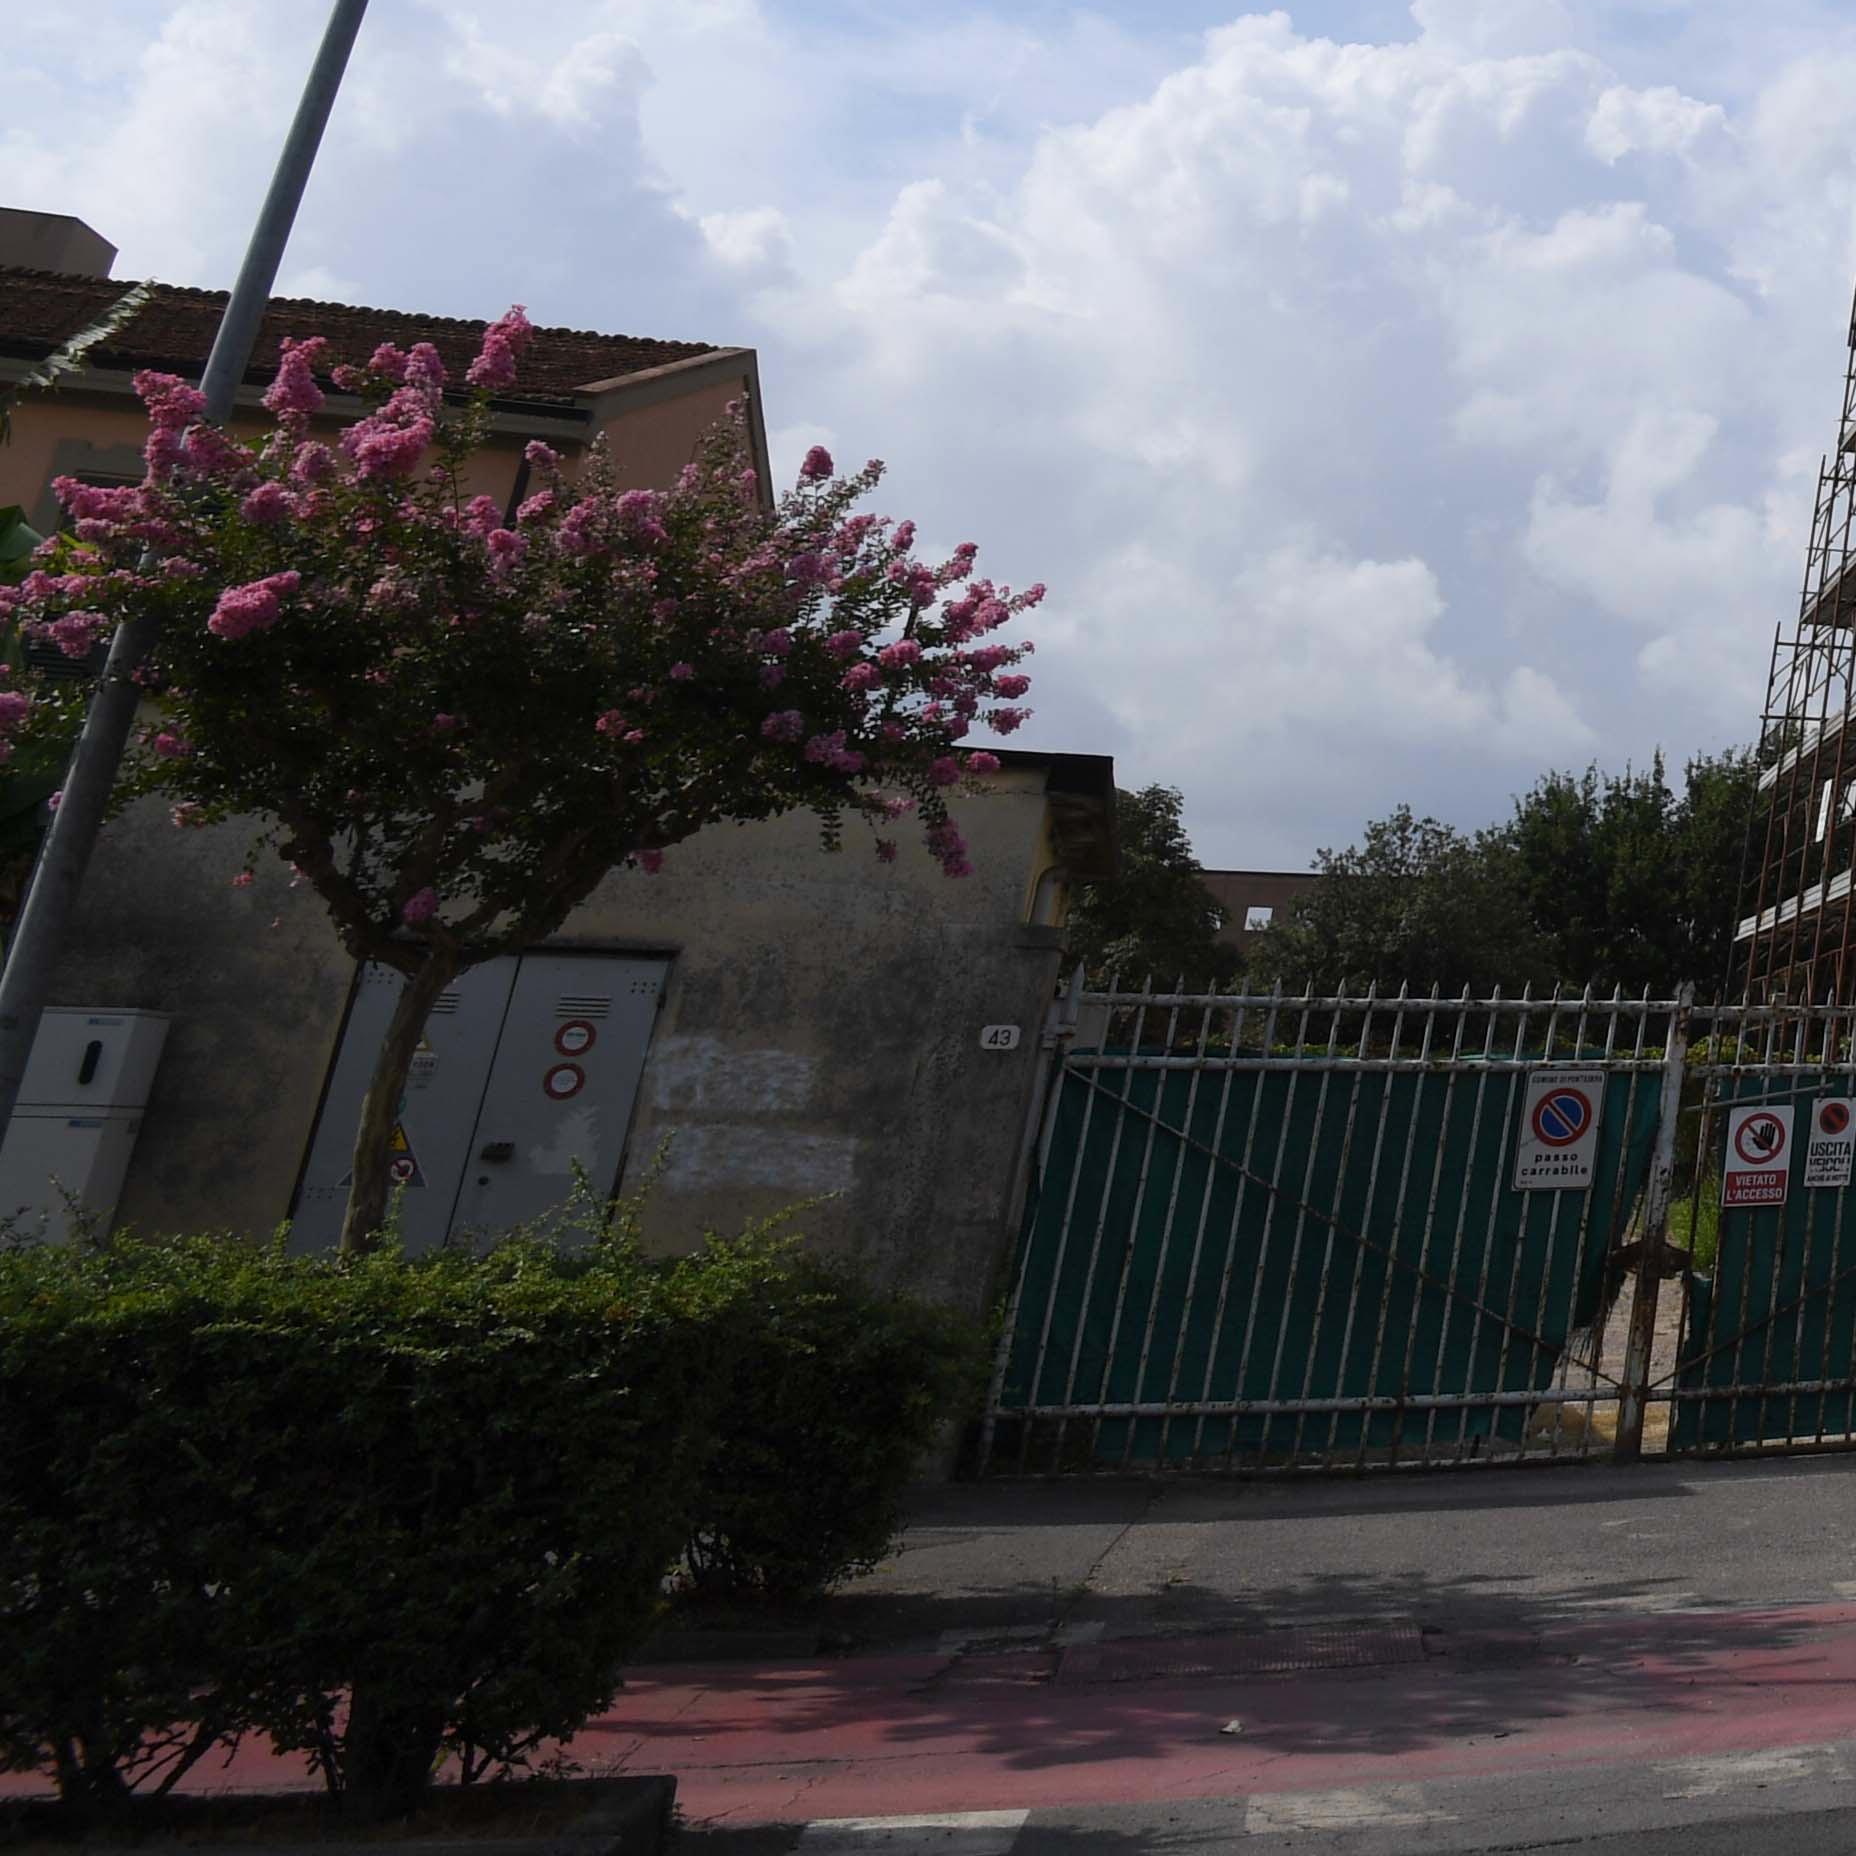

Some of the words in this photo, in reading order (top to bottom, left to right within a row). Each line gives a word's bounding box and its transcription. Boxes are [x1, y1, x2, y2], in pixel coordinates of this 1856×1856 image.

[988, 1029, 1012, 1046] 43
[1810, 1141, 1851, 1156] USCITA
[1534, 1153, 1578, 1164] passo
[1521, 1165, 1588, 1176] carrabile
[1735, 1174, 1777, 1186] VIETATO
[1727, 1188, 1783, 1201] L'ACCESSO
